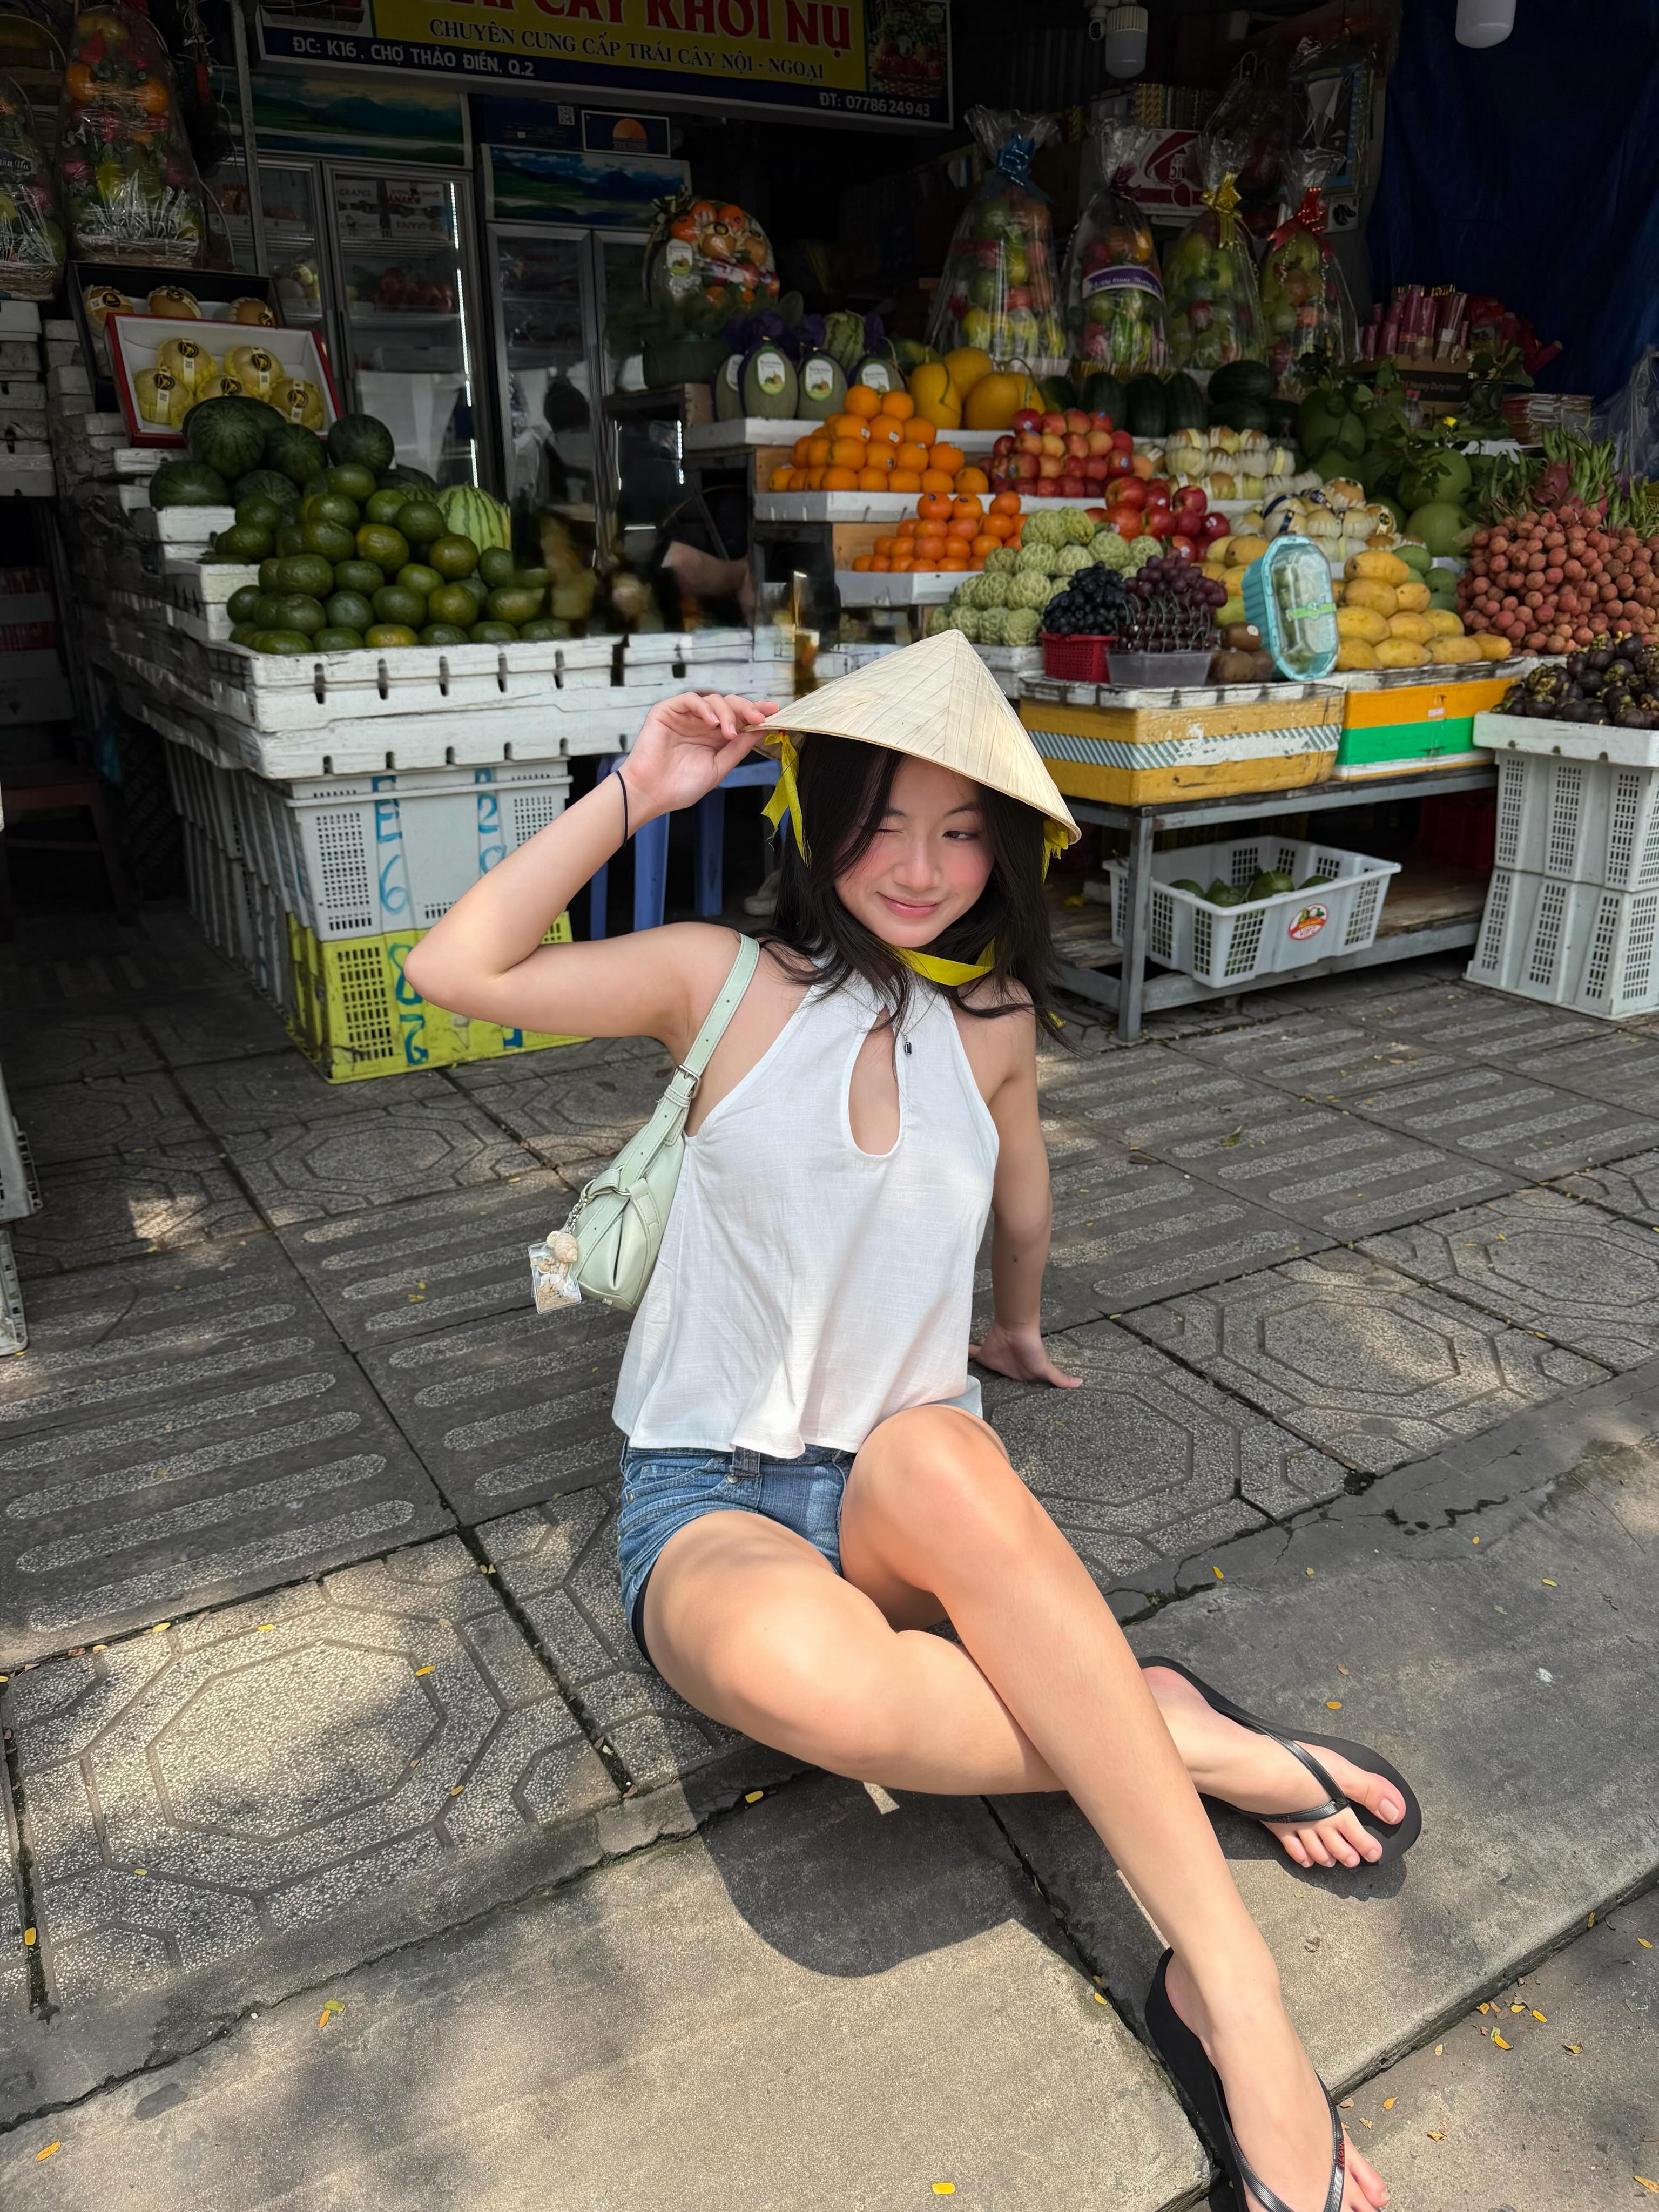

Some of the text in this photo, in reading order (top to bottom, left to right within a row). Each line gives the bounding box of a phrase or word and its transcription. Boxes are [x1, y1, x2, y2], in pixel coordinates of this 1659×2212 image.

[430, 18, 514, 45] CHUYÊN
[522, 30, 576, 52] CUNG
[582, 32, 621, 57] CẤP
[626, 41, 671, 62] TRÁI
[678, 45, 715, 67] CÂY
[723, 50, 753, 74] NỘI
[769, 58, 824, 80] NGOẠI
[786, 1, 851, 58] NỤ
[292, 36, 321, 53] ĐC:
[370, 44, 404, 65] CHỢ
[410, 45, 456, 67] THẢO
[508, 59, 535, 77] Q.2
[819, 91, 841, 108] ĐT:
